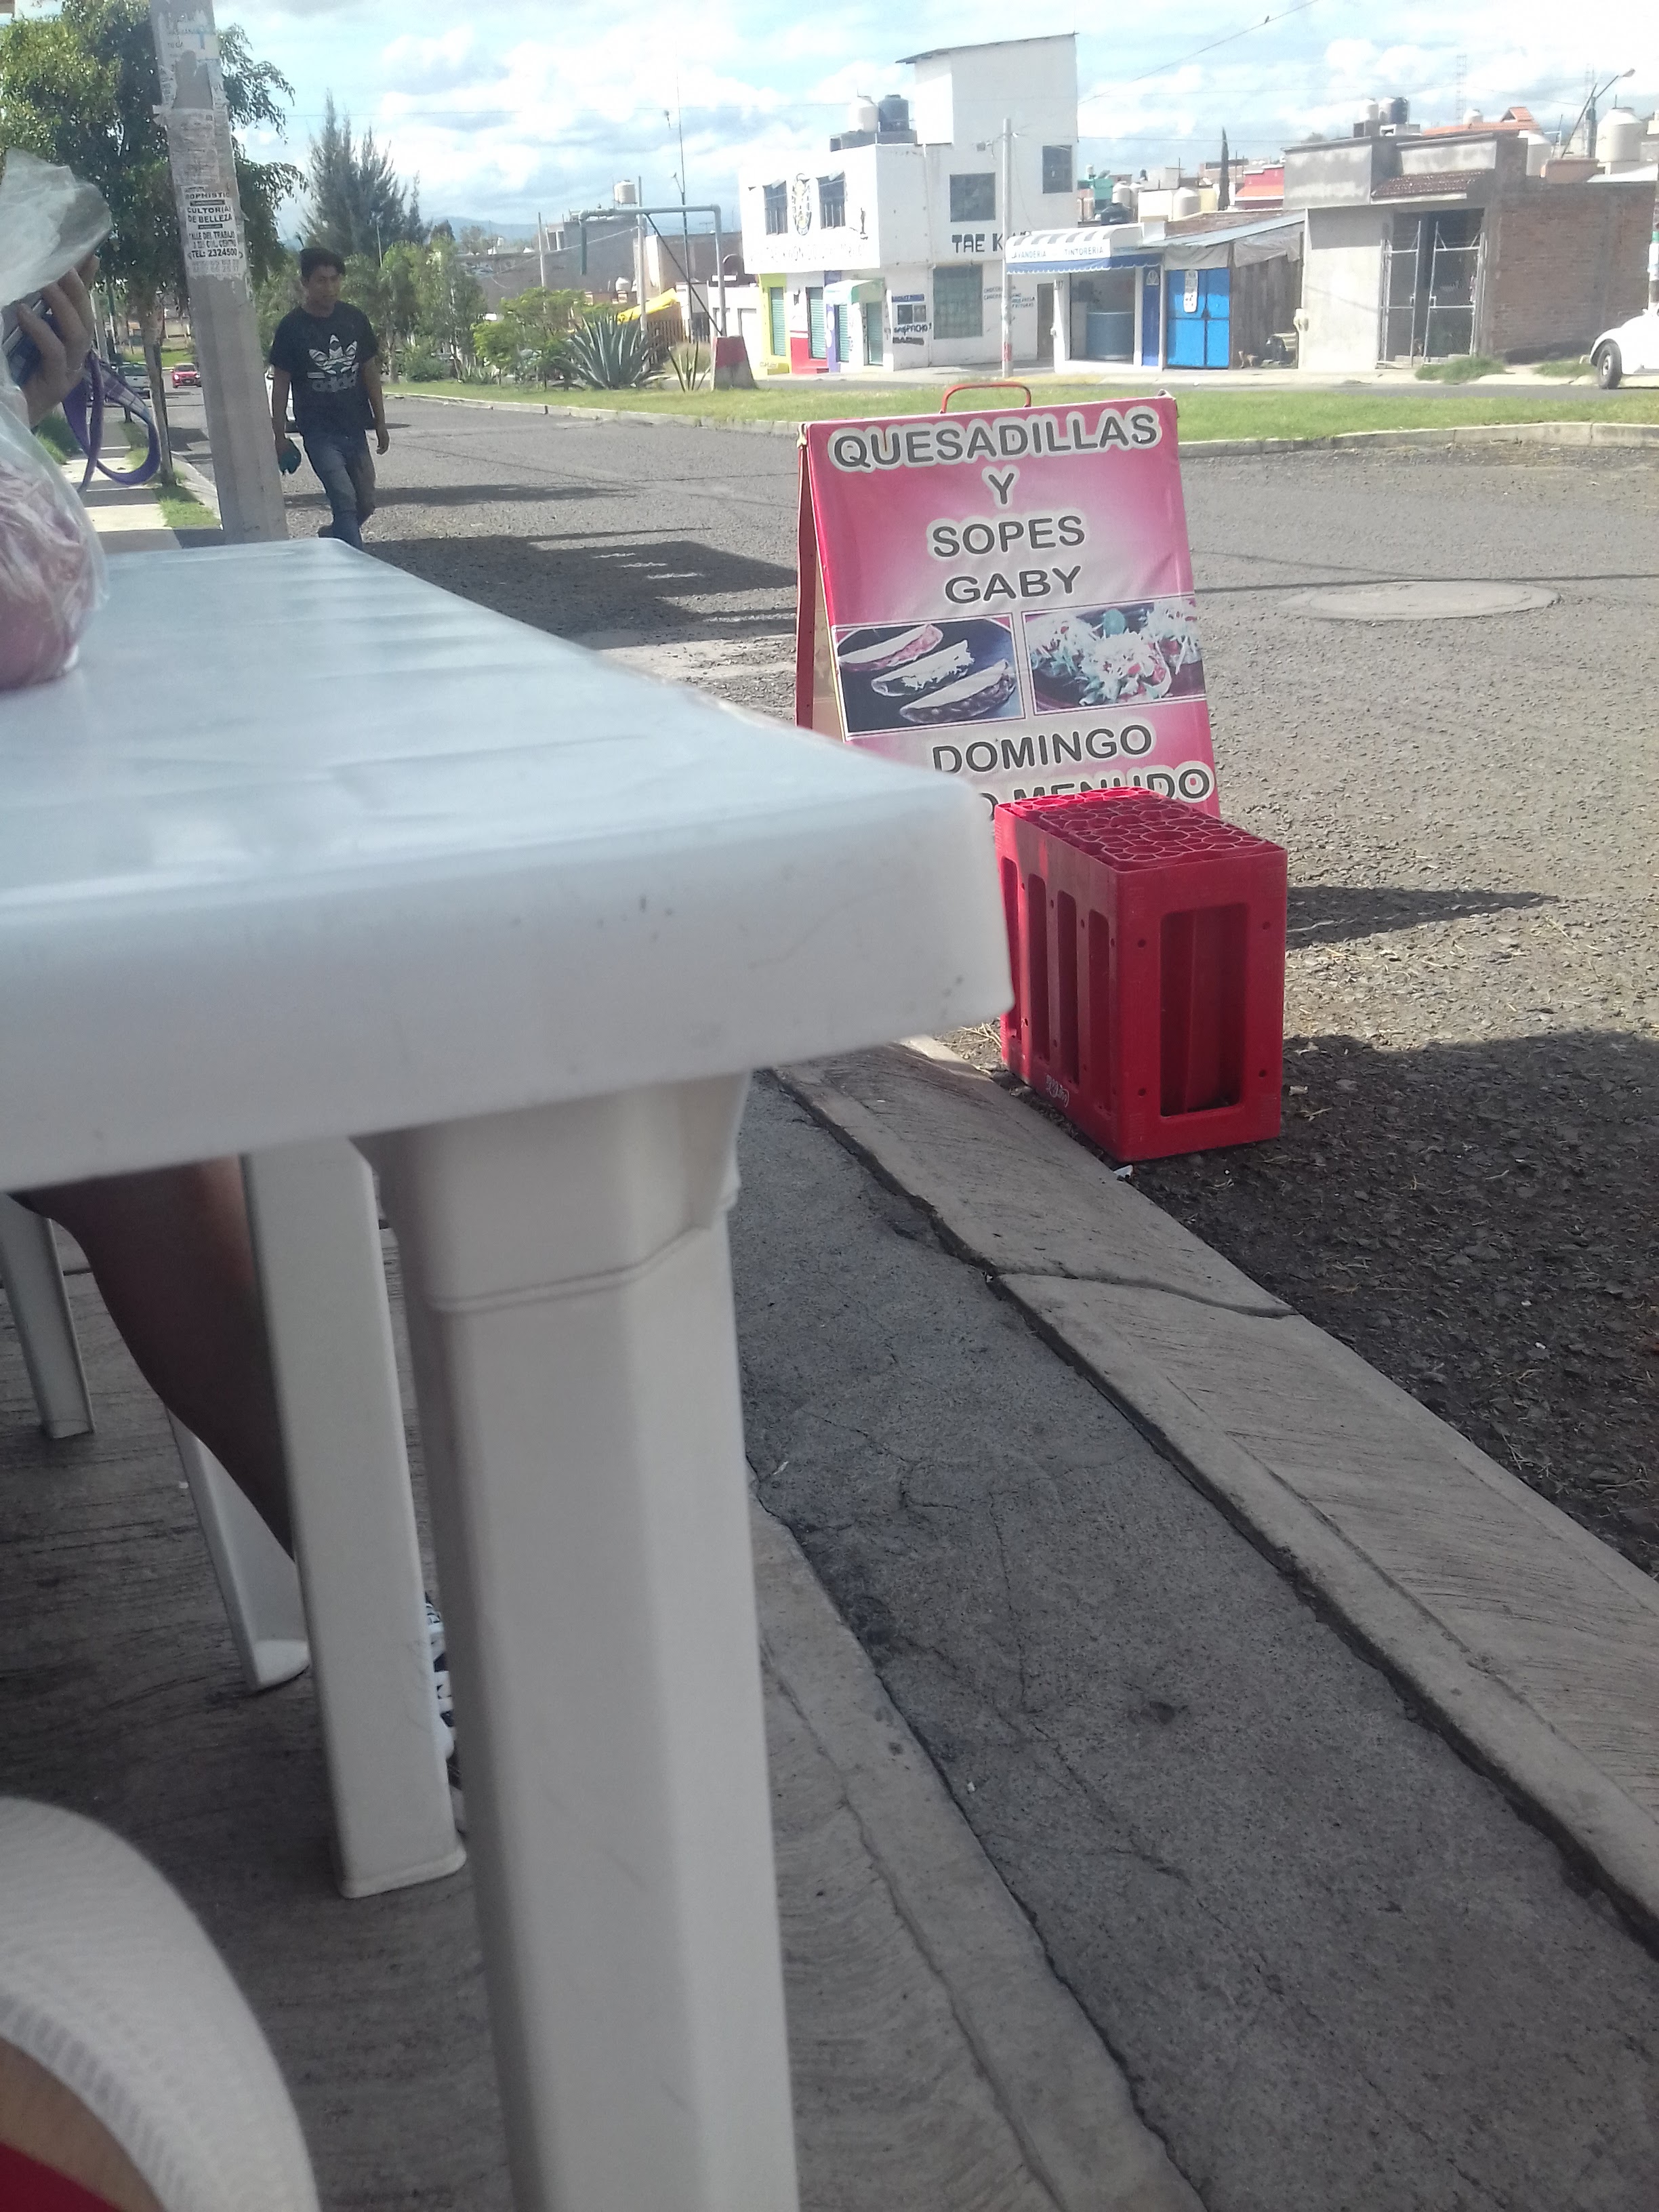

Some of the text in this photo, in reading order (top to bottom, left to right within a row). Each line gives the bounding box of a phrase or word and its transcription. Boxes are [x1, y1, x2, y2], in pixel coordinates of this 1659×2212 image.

[188, 213, 233, 223] DE BELLEZA
[191, 249, 206, 258] TEL:
[951, 233, 985, 253] TAE
[1064, 246, 1104, 255] TINTORERIA
[833, 412, 1159, 468] QUESADILLAS
[987, 472, 1015, 506] Y
[932, 515, 1086, 558] SOPES
[945, 565, 1082, 605] GABY
[933, 724, 1153, 773] DOMINGO
